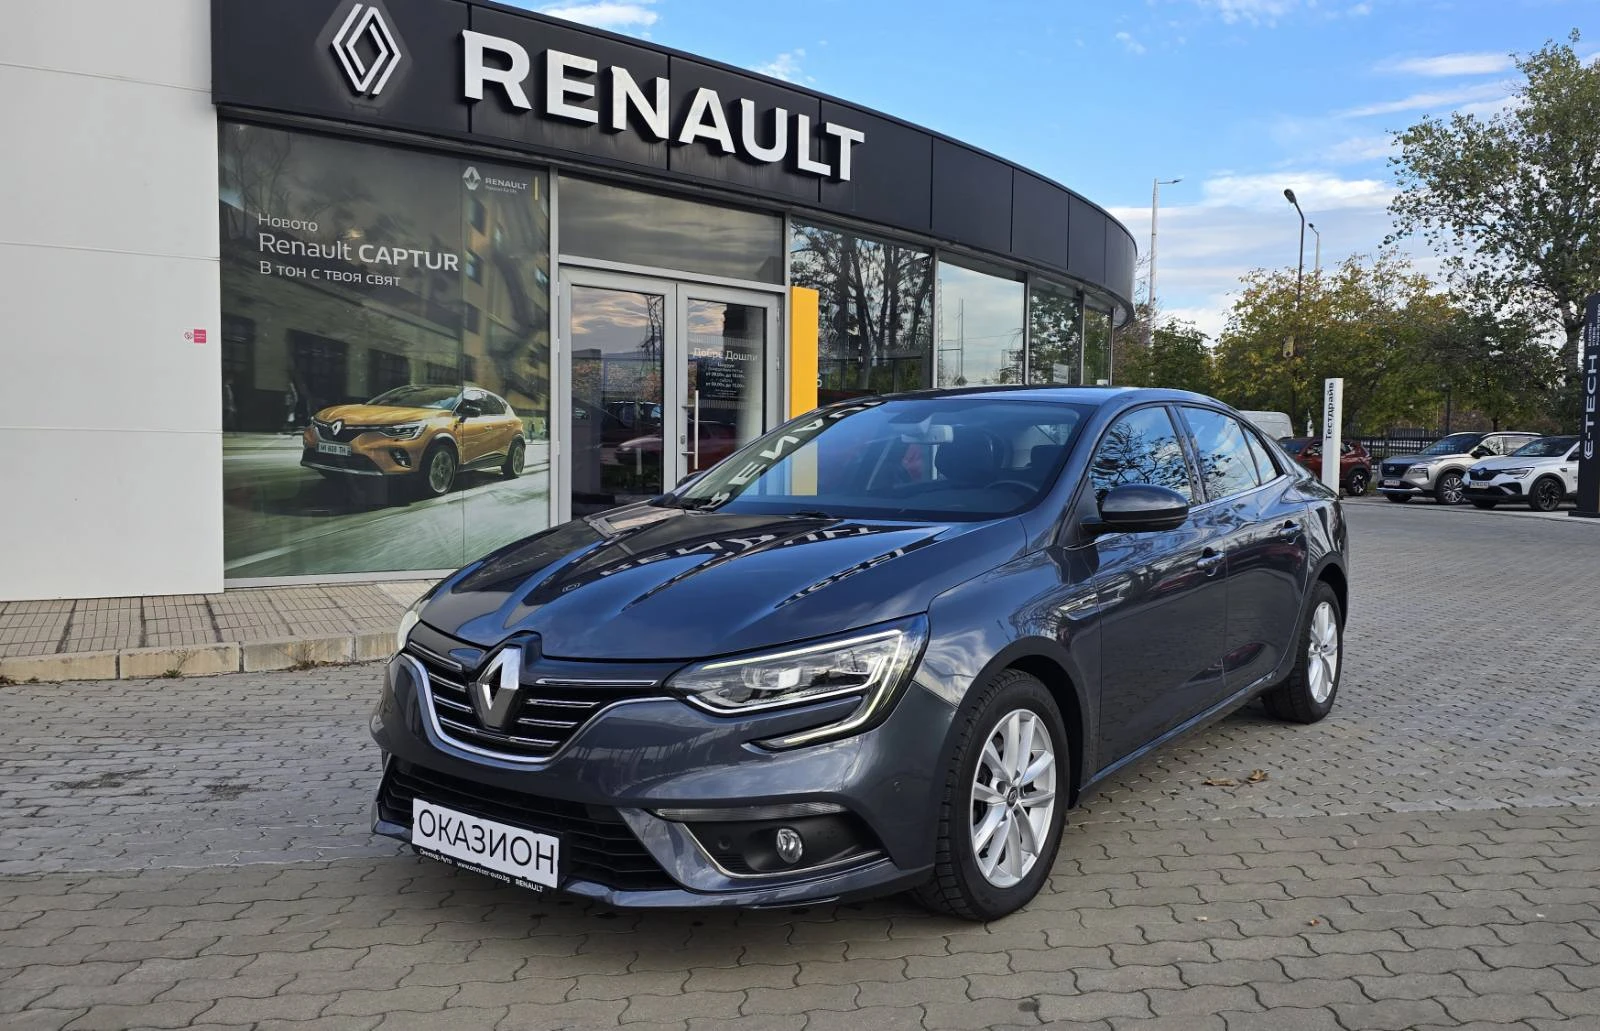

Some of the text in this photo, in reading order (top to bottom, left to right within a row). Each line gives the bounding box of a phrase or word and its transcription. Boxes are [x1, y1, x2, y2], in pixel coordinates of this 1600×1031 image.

[462, 29, 864, 181] RENAULT
[485, 177, 528, 190] RENAULT
[258, 213, 318, 232] Новото
[259, 232, 459, 272] Renault CAPTUR
[260, 261, 401, 287] В тон с твоя свят
[1326, 382, 1335, 440] Тестдрайв
[1584, 354, 1598, 460] E-TECH
[419, 809, 554, 874] ОКАЗИОН
[515, 878, 544, 893] RENAULT
